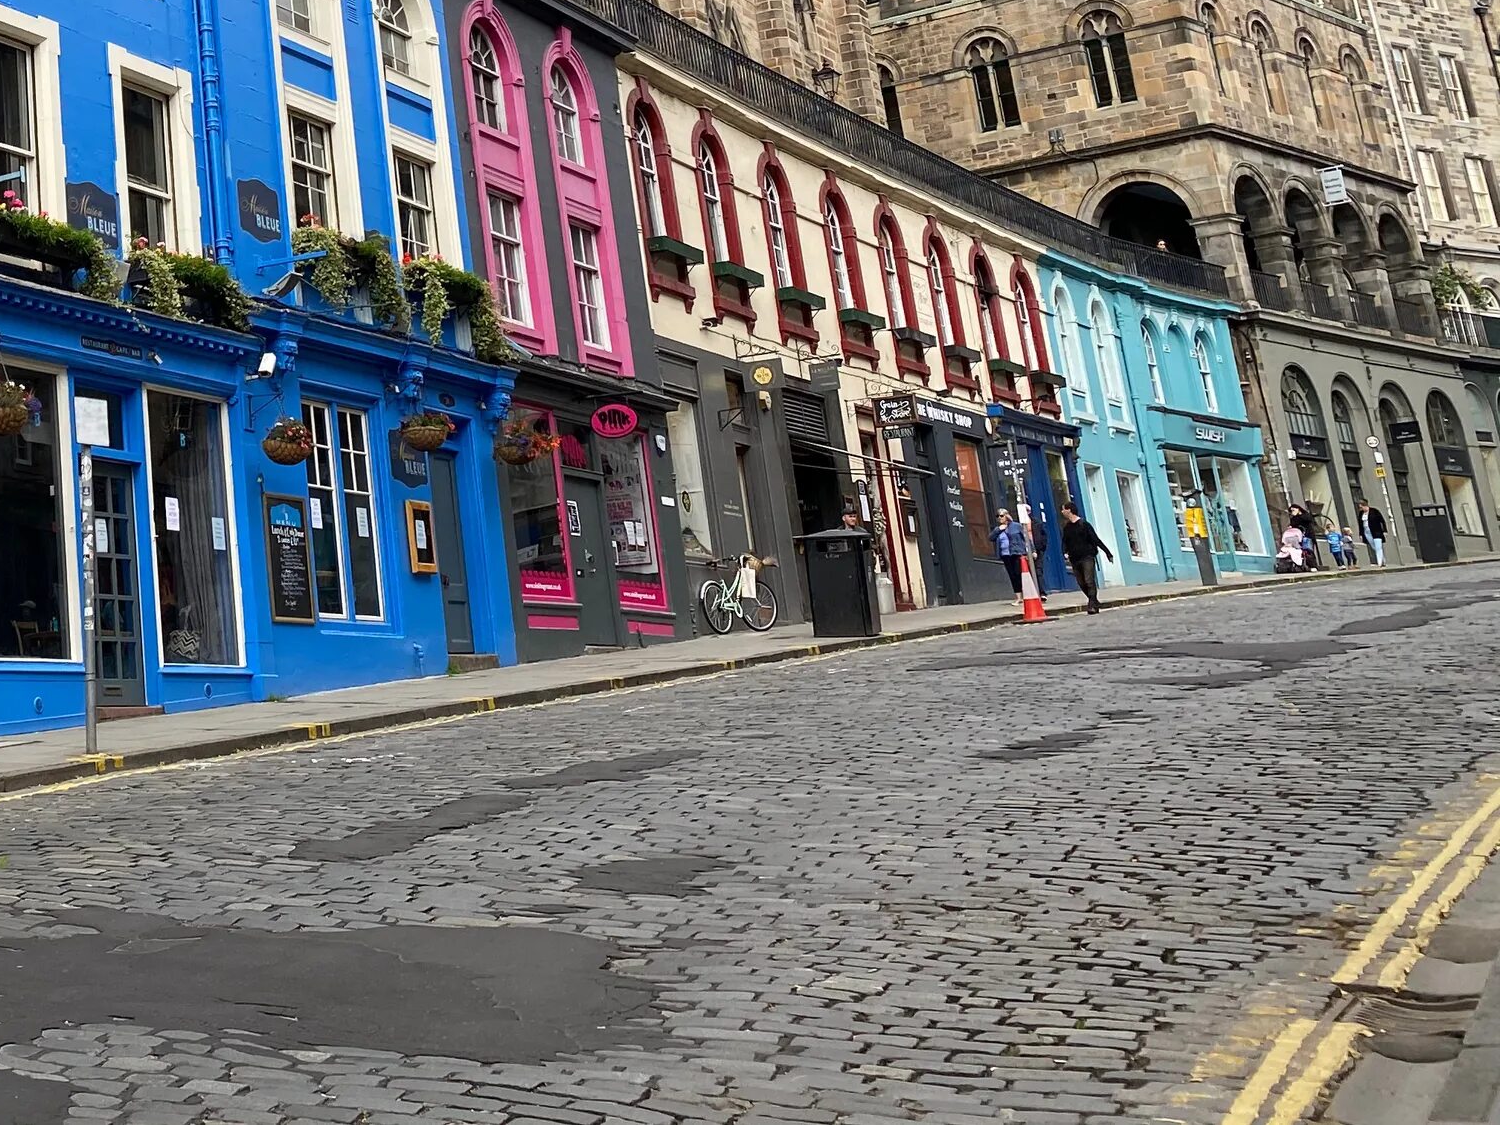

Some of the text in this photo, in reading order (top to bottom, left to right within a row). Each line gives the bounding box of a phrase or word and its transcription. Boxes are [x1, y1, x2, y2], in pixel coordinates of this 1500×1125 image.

[87, 216, 118, 238] BLEUE
[256, 214, 281, 234] BLEUE
[926, 404, 954, 424] WHISKY
[954, 412, 972, 428] SHOP
[883, 426, 915, 438] RESTAURANT
[1196, 427, 1225, 443] SWISH
[404, 460, 426, 476] BLEUE
[997, 458, 1028, 468] WHSKY
